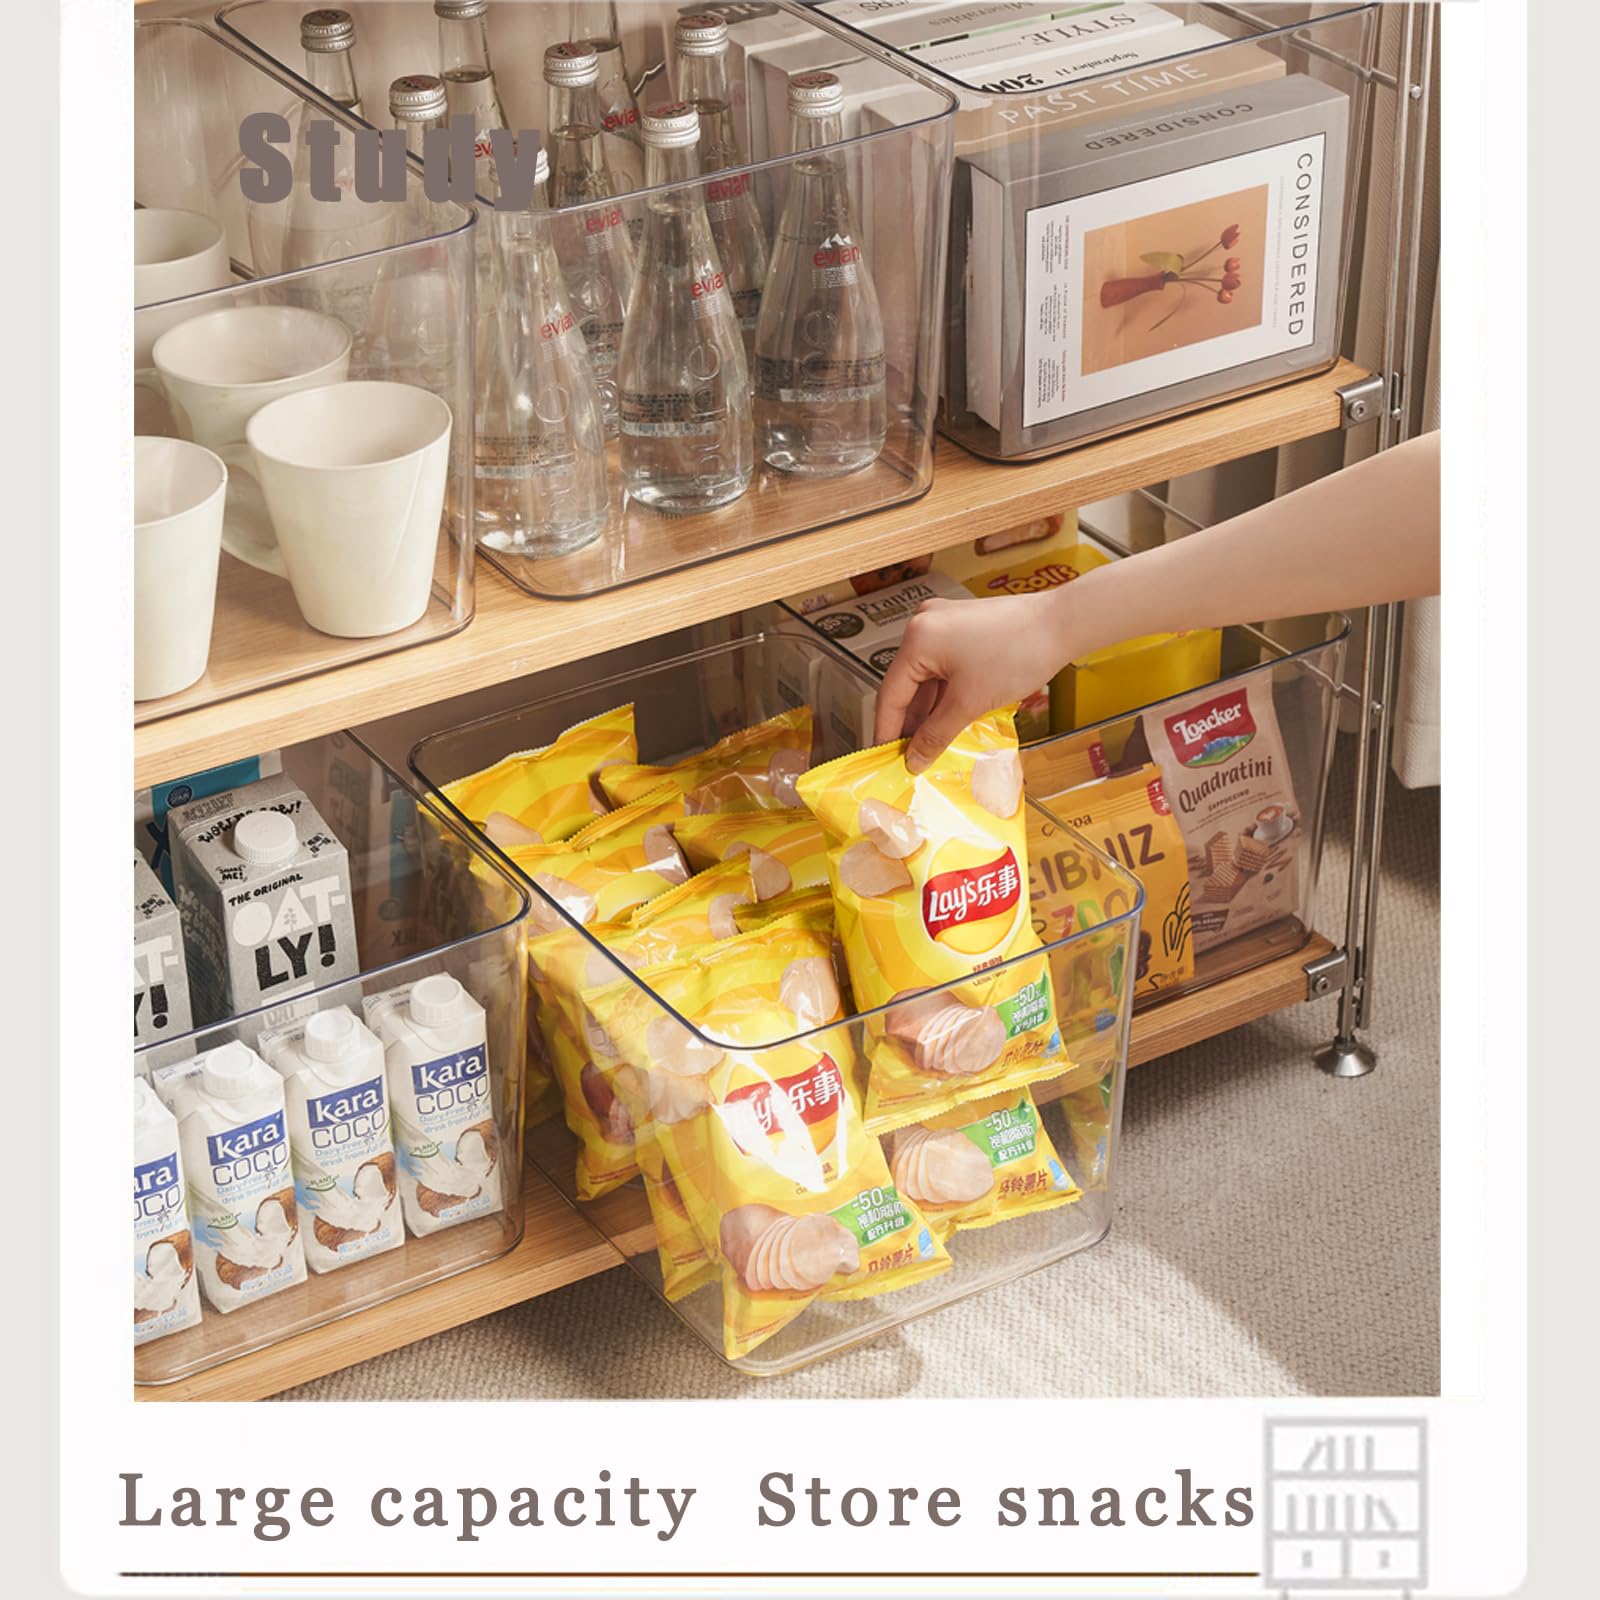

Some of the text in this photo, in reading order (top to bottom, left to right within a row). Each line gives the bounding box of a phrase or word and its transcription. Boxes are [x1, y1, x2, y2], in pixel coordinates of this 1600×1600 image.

[1021, 12, 1137, 46] STYLE
[998, 63, 1209, 124] PAST TIME
[1085, 103, 1254, 151] CONSIDERED
[1288, 153, 1313, 335] CONSIDERED
[690, 271, 724, 299] evia
[1172, 703, 1242, 745] Loacker
[1178, 756, 1273, 814] Quadratini
[228, 874, 303, 906] THE ORIGINAL
[977, 864, 1018, 906] 乐事
[255, 923, 336, 991] LY!
[420, 1054, 483, 1089] kara
[315, 1086, 379, 1124] kara
[416, 1074, 488, 1115] COCO
[216, 1122, 280, 1159] kara
[312, 1107, 386, 1149] COCO
[213, 1141, 288, 1186] COCO
